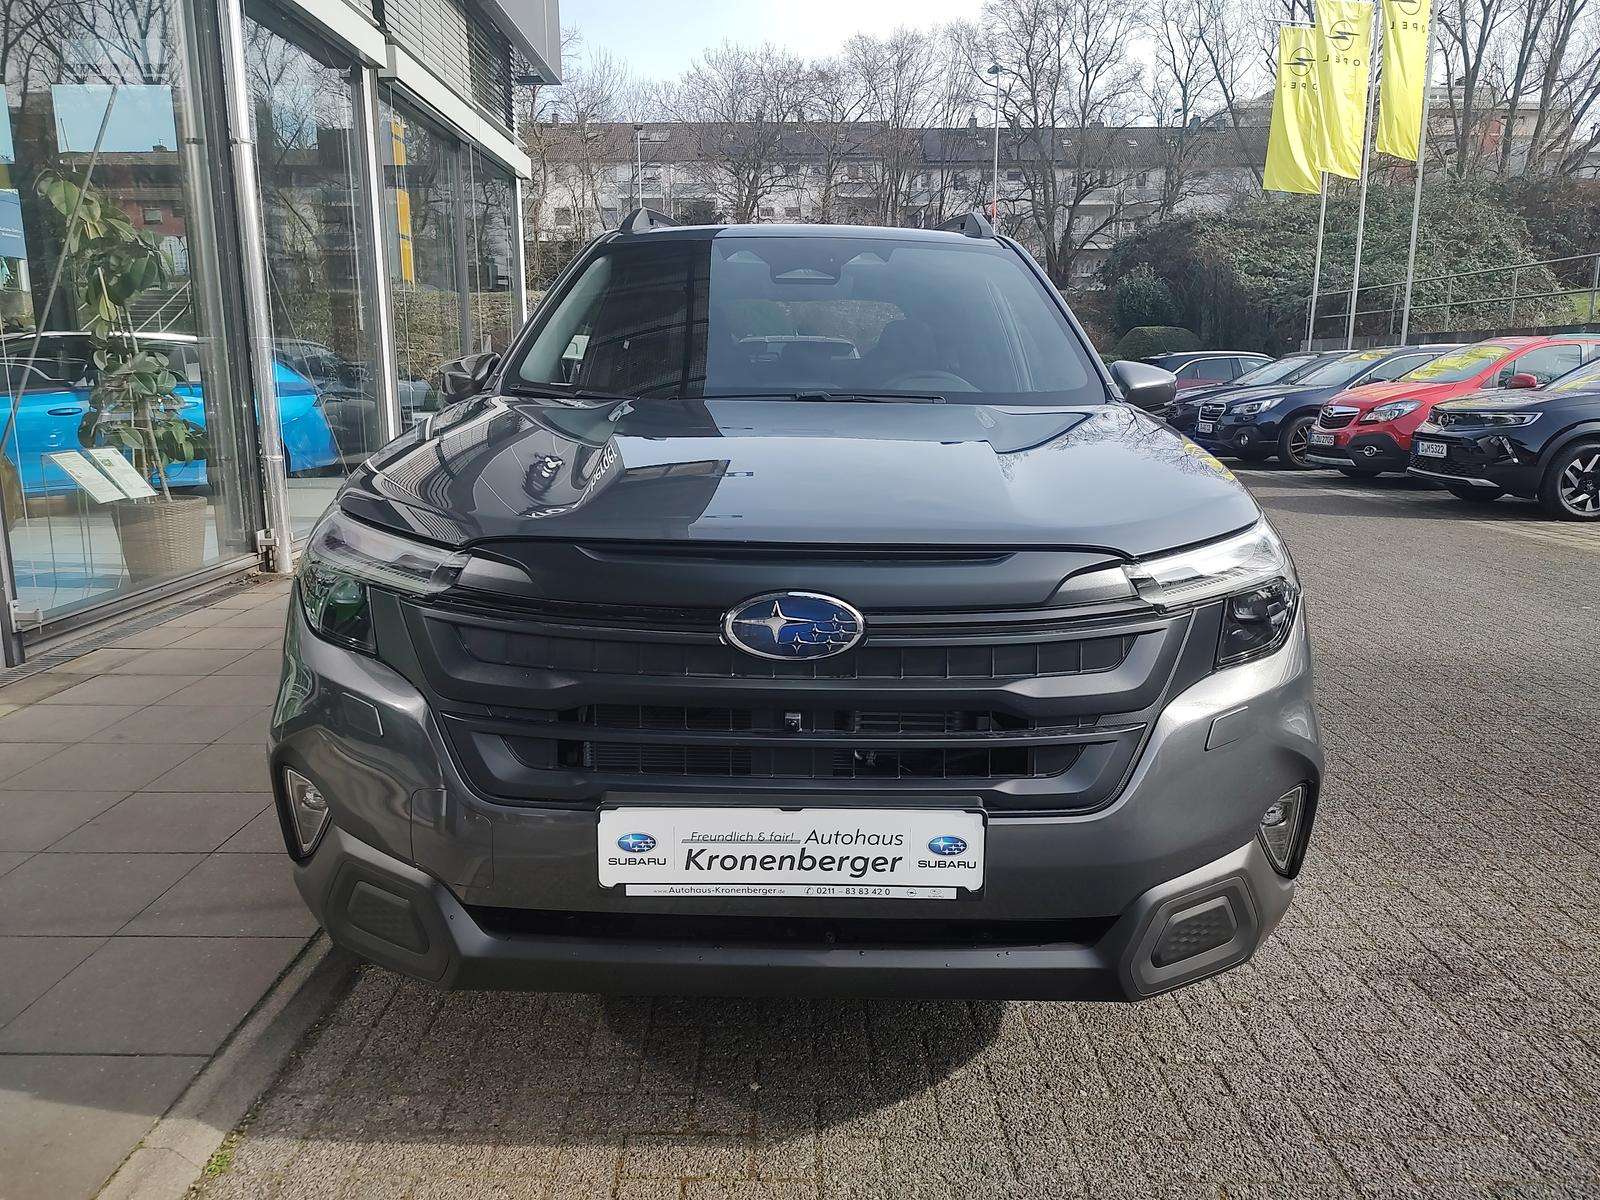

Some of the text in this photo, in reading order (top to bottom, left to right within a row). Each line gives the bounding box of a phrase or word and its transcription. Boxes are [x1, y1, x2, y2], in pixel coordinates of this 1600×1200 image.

[690, 831, 795, 845] Freundlich & fair!
[804, 828, 904, 846] Autohaus
[608, 857, 667, 866] SUBARU
[684, 847, 903, 879] Kronenberger
[917, 860, 977, 869] SUBARU
[816, 887, 836, 895] 0211
